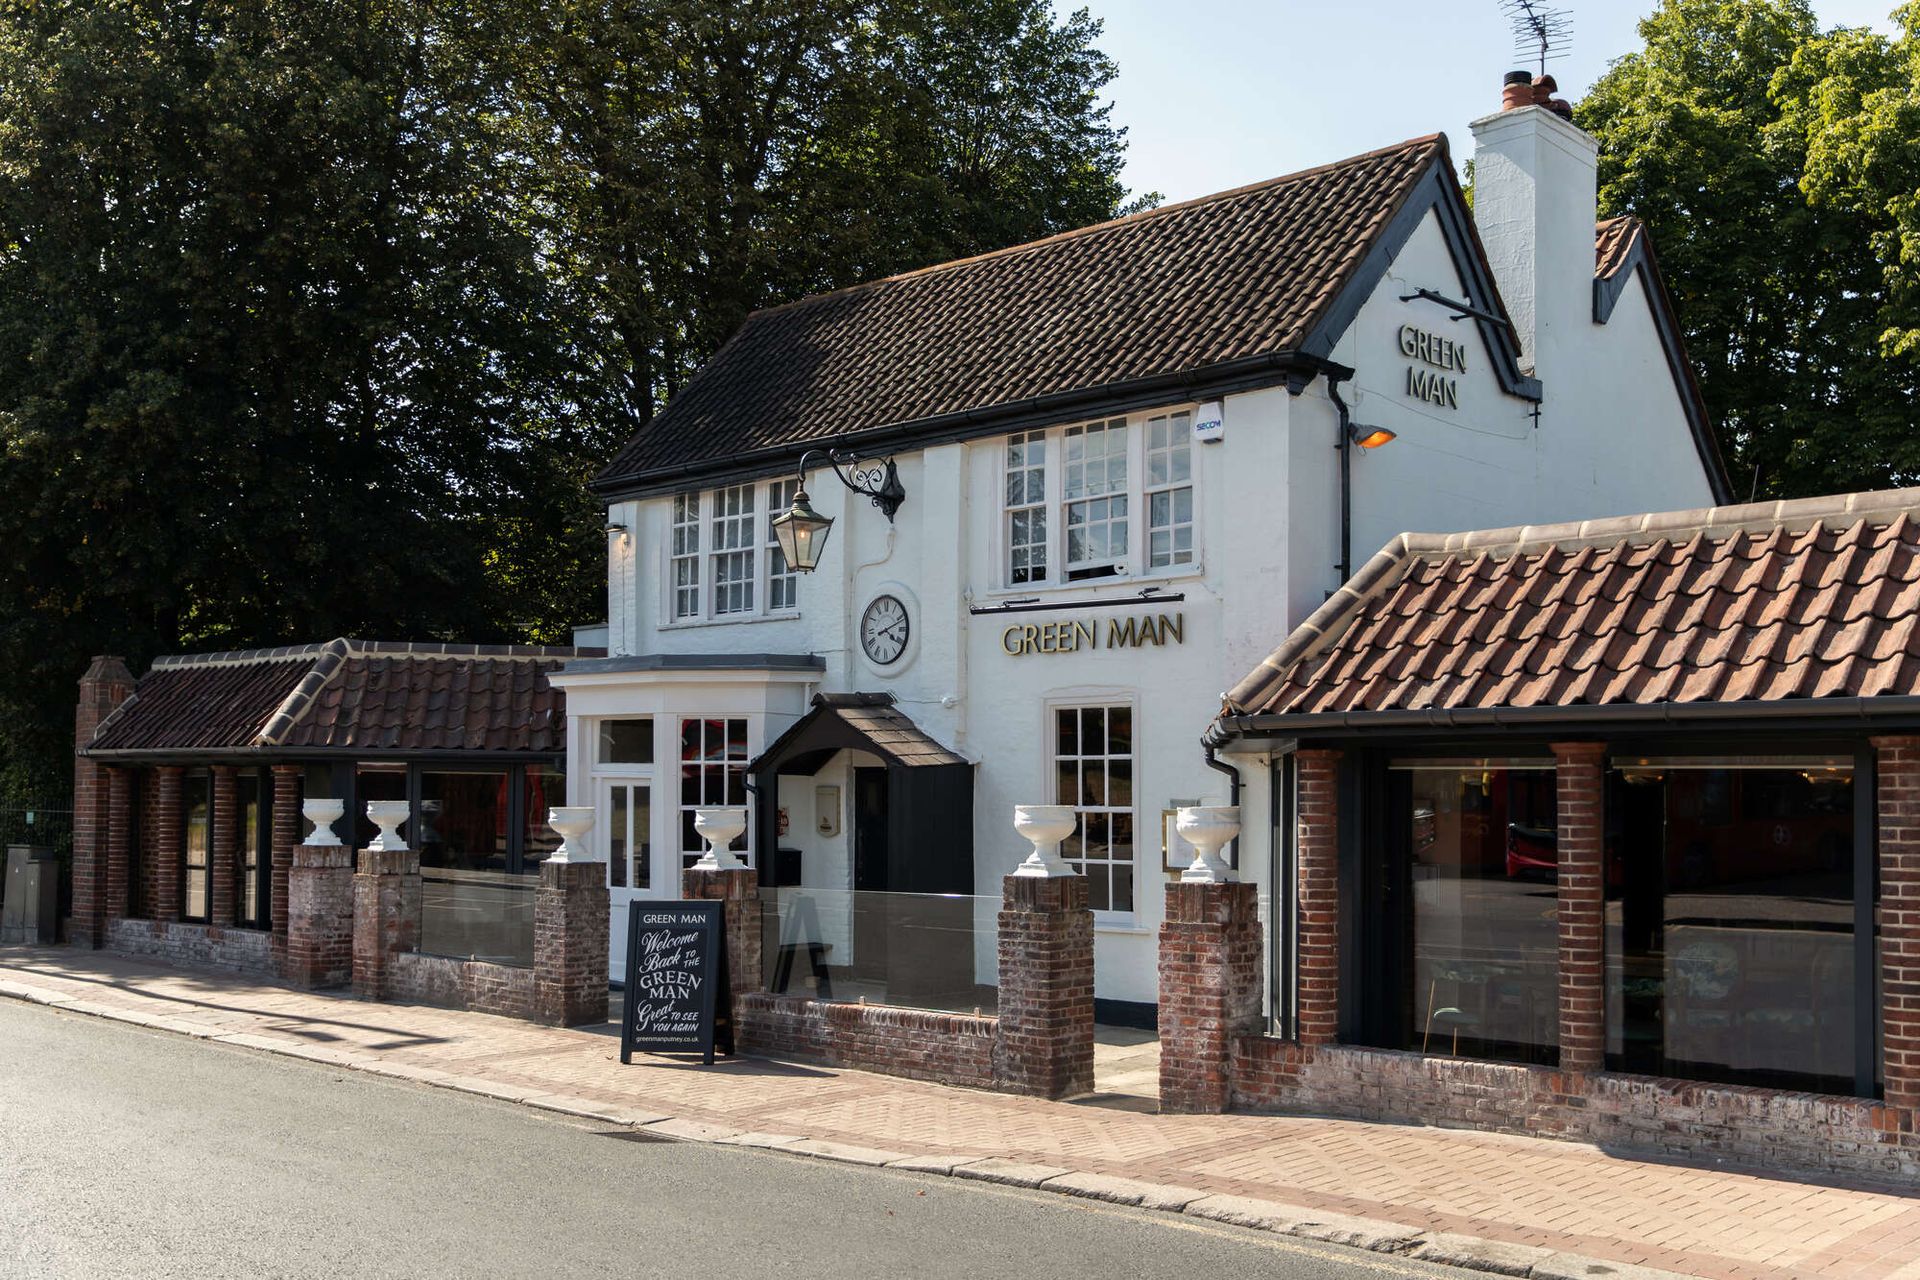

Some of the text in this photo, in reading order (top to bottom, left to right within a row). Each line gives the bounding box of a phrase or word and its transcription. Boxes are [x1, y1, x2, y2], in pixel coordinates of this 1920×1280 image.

[1398, 323, 1466, 375] GREEN
[1407, 366, 1457, 410] MAN
[1002, 612, 1183, 656] GREEN MAN
[643, 914, 706, 924] GREEN MAN
[641, 929, 699, 955] Welcome
[639, 946, 696, 974] Back TO
[683, 957, 700, 968] THE
[640, 970, 702, 990] GREEN
[650, 985, 690, 1000] MAN
[636, 999, 699, 1031] Great TO SEE
[653, 1023, 699, 1032] YOU AGAIN
